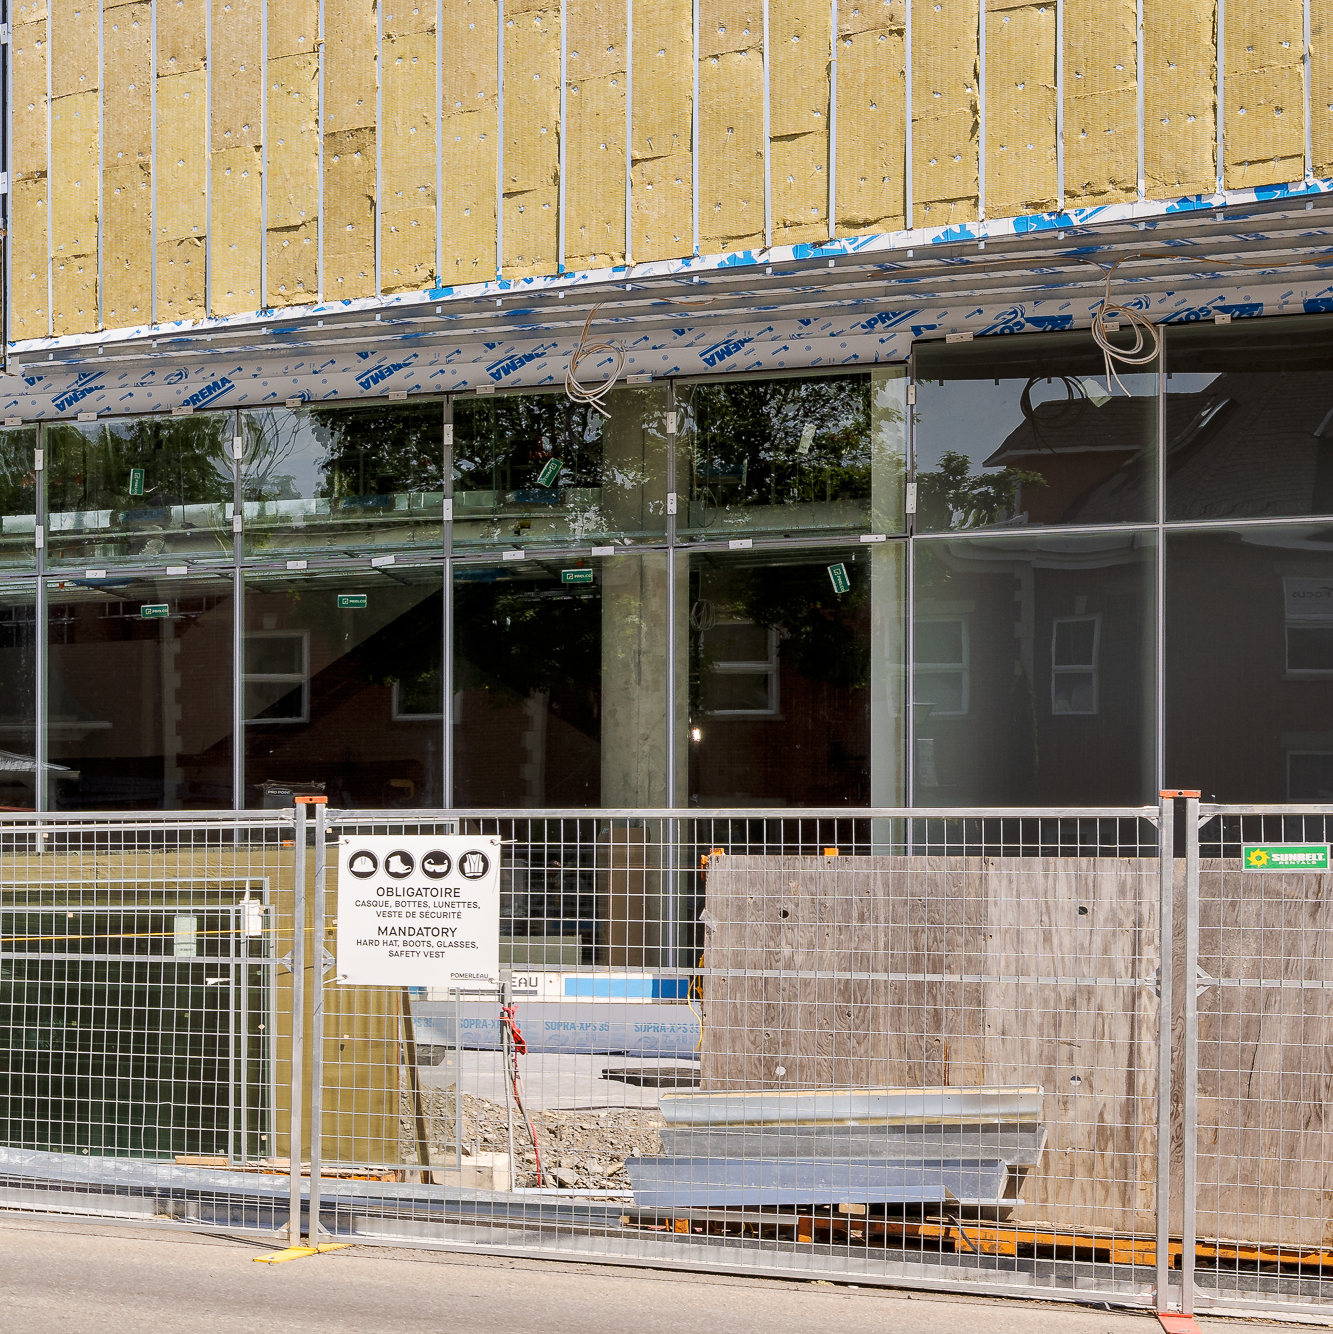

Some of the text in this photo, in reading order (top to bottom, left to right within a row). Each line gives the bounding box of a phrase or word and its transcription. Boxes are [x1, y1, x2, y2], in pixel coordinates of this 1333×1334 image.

[1272, 853, 1324, 862] SUNBELT
[376, 887, 461, 897] OBLIGATOIRE
[355, 900, 481, 910] CASQUE, BOTTES, LUNETTES,
[376, 910, 403, 918] VESTE
[419, 910, 462, 919] SÉCURITÉ
[377, 926, 457, 937] MANDATORY
[402, 940, 434, 948] BOOTS,
[436, 941, 479, 949] GLASSES,
[388, 950, 445, 958] SAFETY VEST
[599, 1022, 610, 1032] 35
